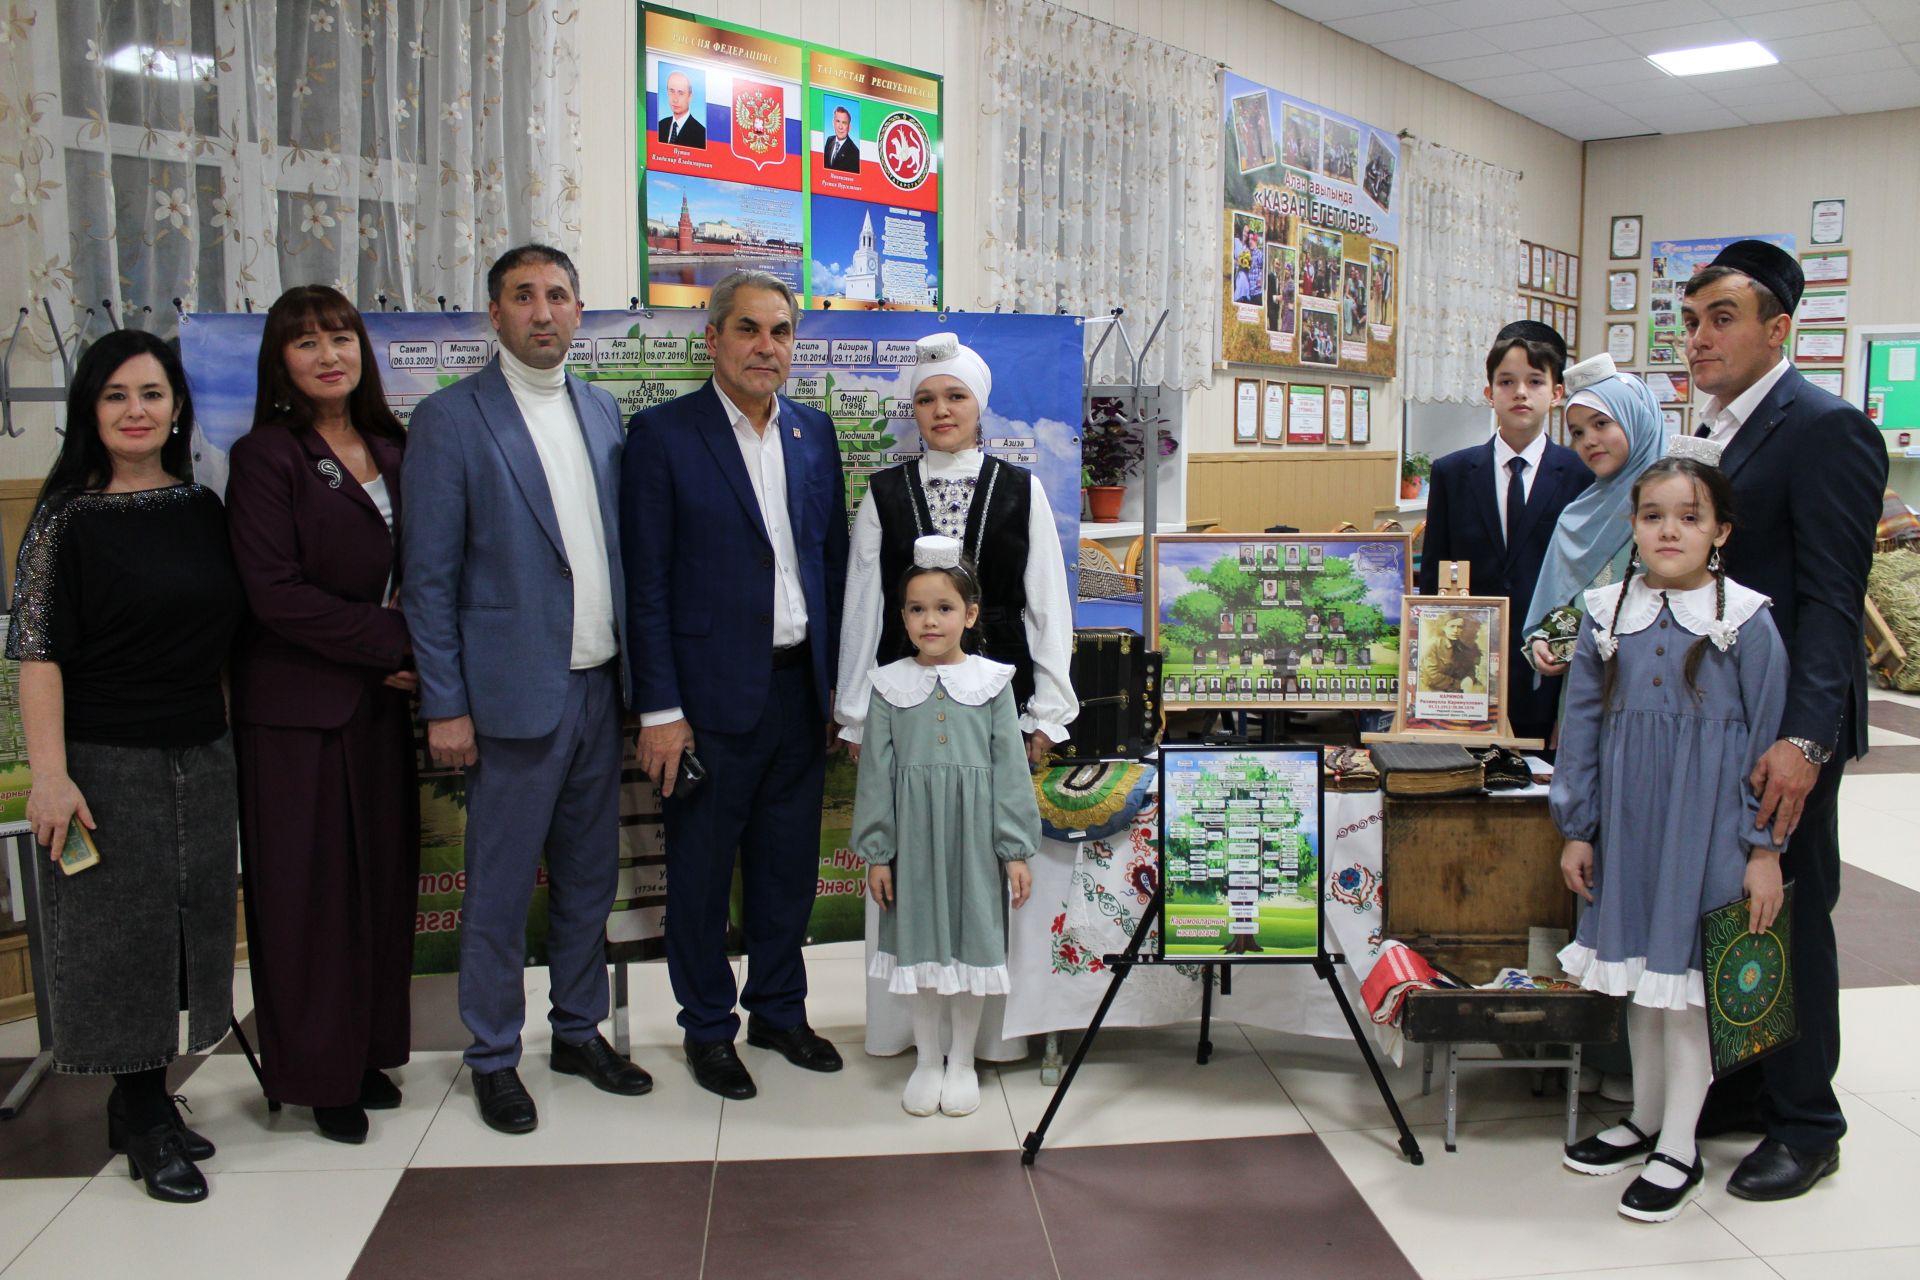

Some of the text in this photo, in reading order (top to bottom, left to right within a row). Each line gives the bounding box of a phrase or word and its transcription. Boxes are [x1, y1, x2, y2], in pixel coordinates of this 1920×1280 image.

[1311, 200, 1378, 235] ЕГЕТЛӘРЕ»
[450, 344, 479, 352] Мәлика
[612, 340, 627, 348] Аяз
[653, 340, 677, 348] Камал
[796, 342, 820, 350] Асилә
[837, 343, 868, 352] Айзирәк
[399, 345, 427, 353] Самат
[391, 356, 438, 366] (06.03.2020)
[443, 356, 488, 366] (17.09.2011)
[597, 352, 642, 361] (13.11.2012)
[644, 352, 688, 361] (09.07.2016)
[793, 353, 829, 362] 3.10.2014)
[832, 353, 874, 362] (29.11.2016)
[877, 354, 919, 363] (04.01.2020)
[640, 382, 664, 391] Азат
[628, 388, 678, 398] (15.05.1990)
[795, 387, 816, 396] (1990)
[617, 396, 644, 406] лнара
[839, 431, 875, 440] Людмила
[1003, 438, 1025, 447] Азизә
[847, 453, 870, 462] Борис
[893, 454, 918, 463] Светл
